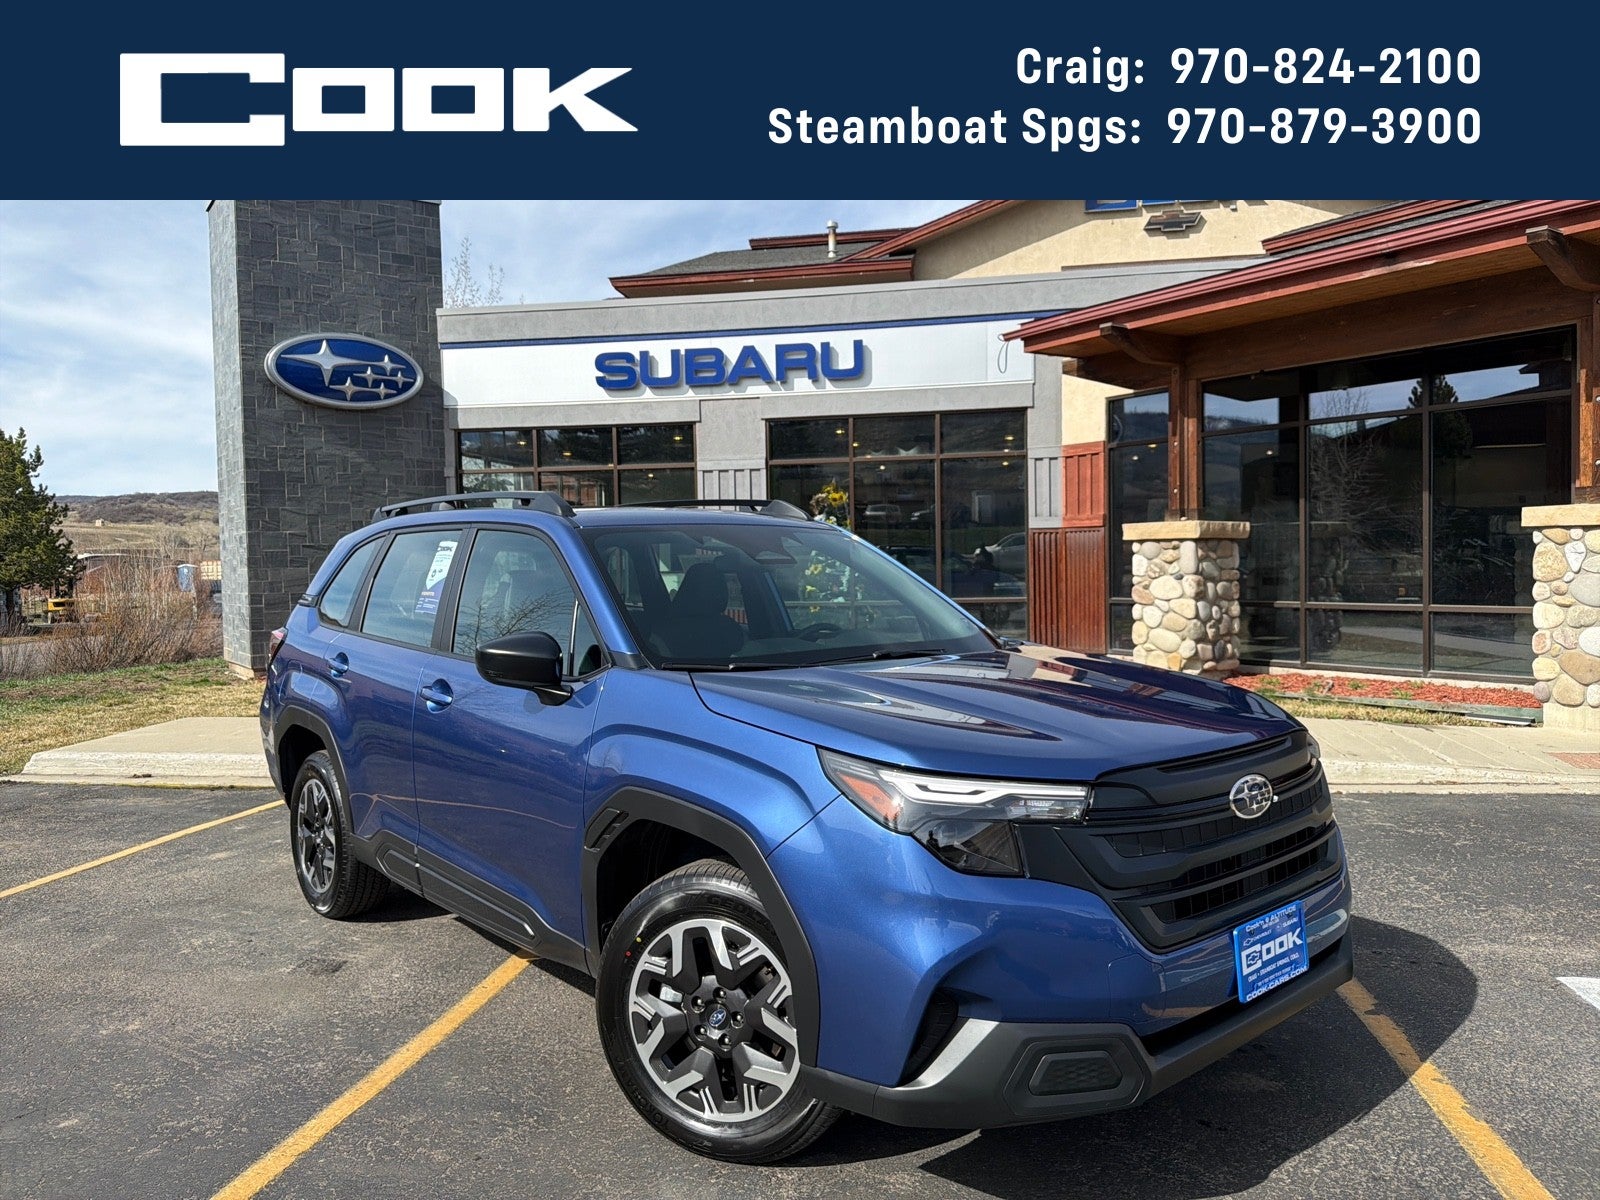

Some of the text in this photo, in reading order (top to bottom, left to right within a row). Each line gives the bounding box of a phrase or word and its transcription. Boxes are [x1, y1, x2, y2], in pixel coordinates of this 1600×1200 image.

[595, 339, 864, 390] SUBARU
[1270, 905, 1296, 920] ALTITUDE
[1283, 917, 1298, 927] SUBARU
[1246, 966, 1308, 1001] COOK-CARS.COM
